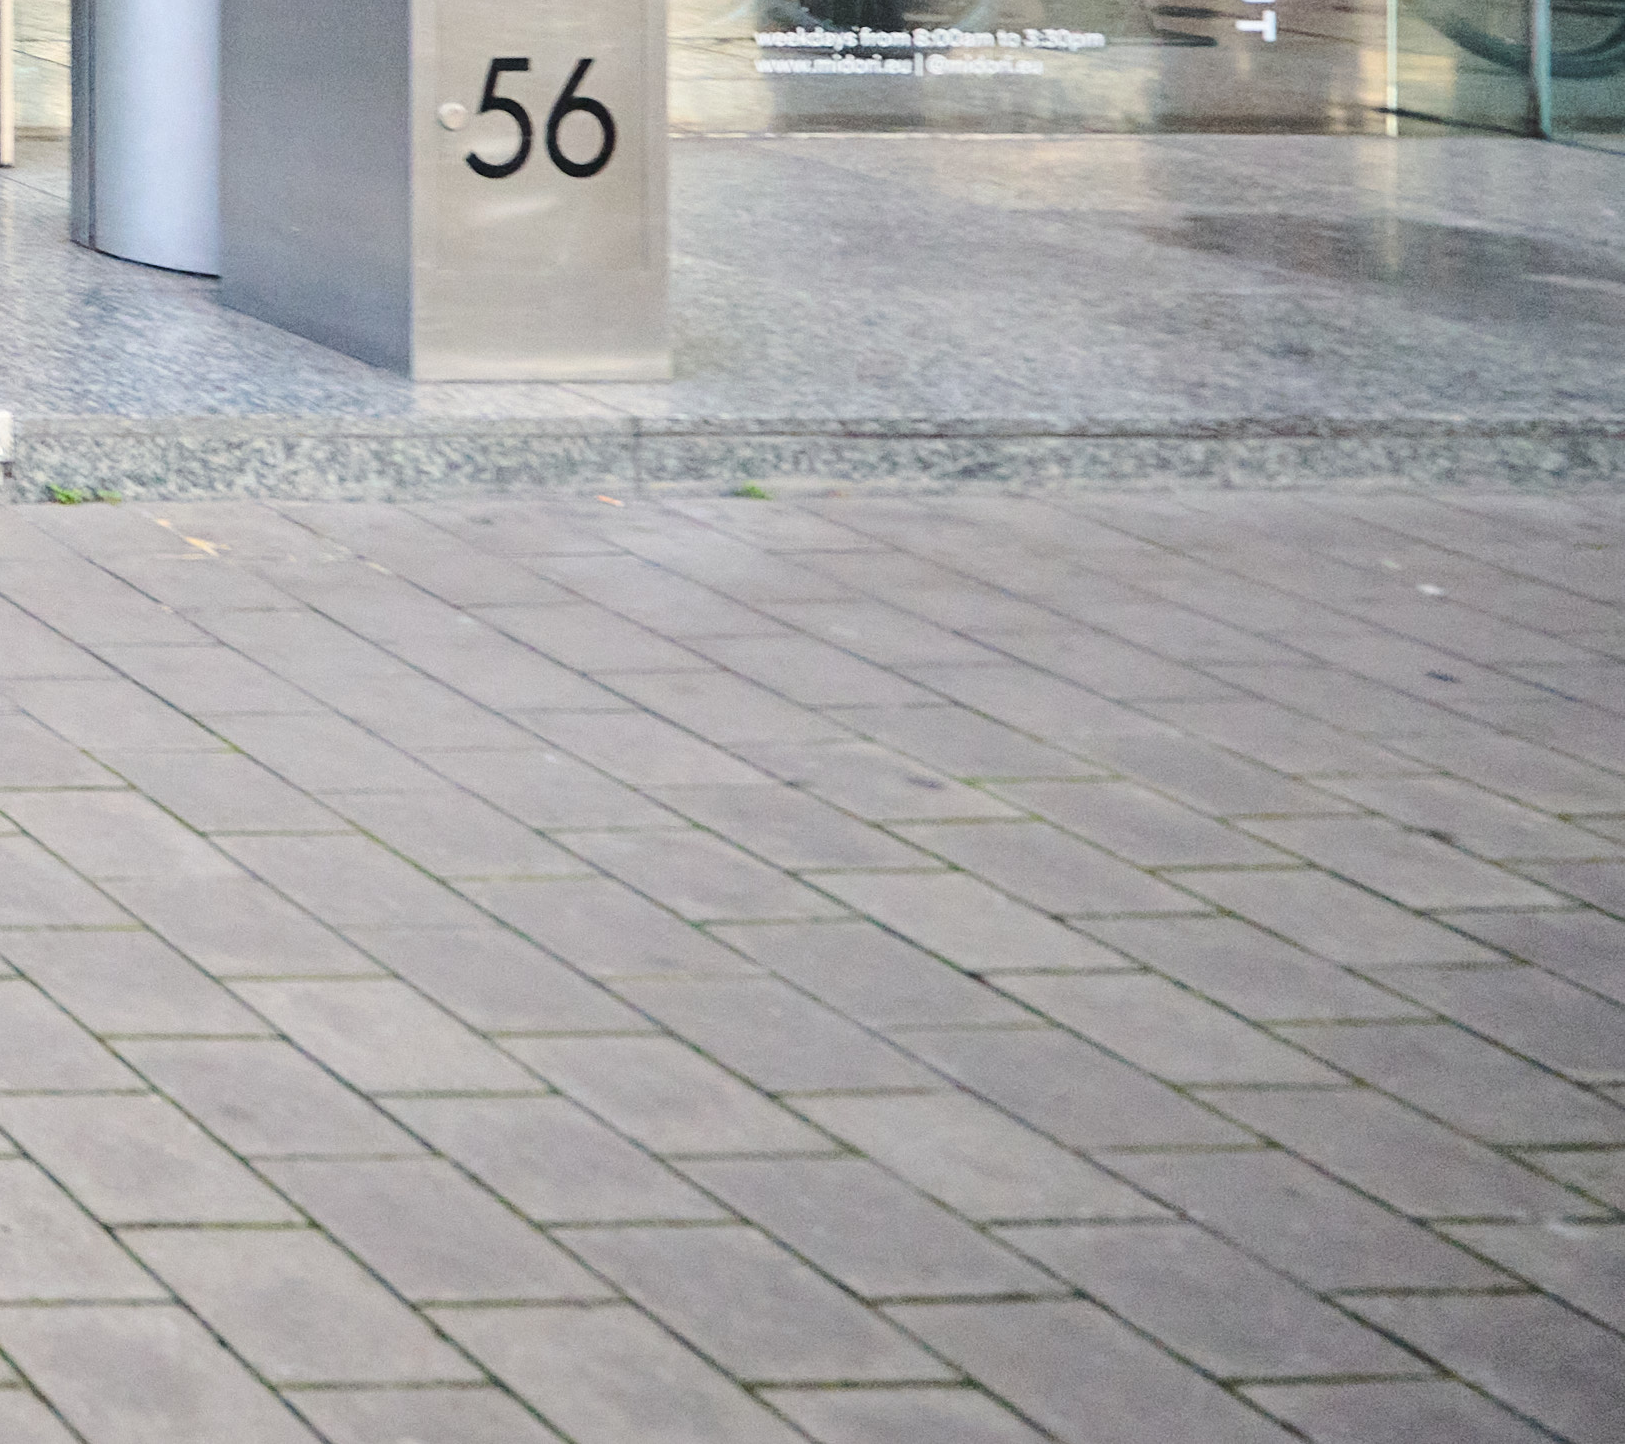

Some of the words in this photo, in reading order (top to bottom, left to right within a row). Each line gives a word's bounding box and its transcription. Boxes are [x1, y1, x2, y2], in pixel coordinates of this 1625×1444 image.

[755, 26, 857, 51] weekdays
[859, 27, 912, 47] from
[755, 54, 913, 75] www.midori.eu
[464, 57, 616, 179] 56
